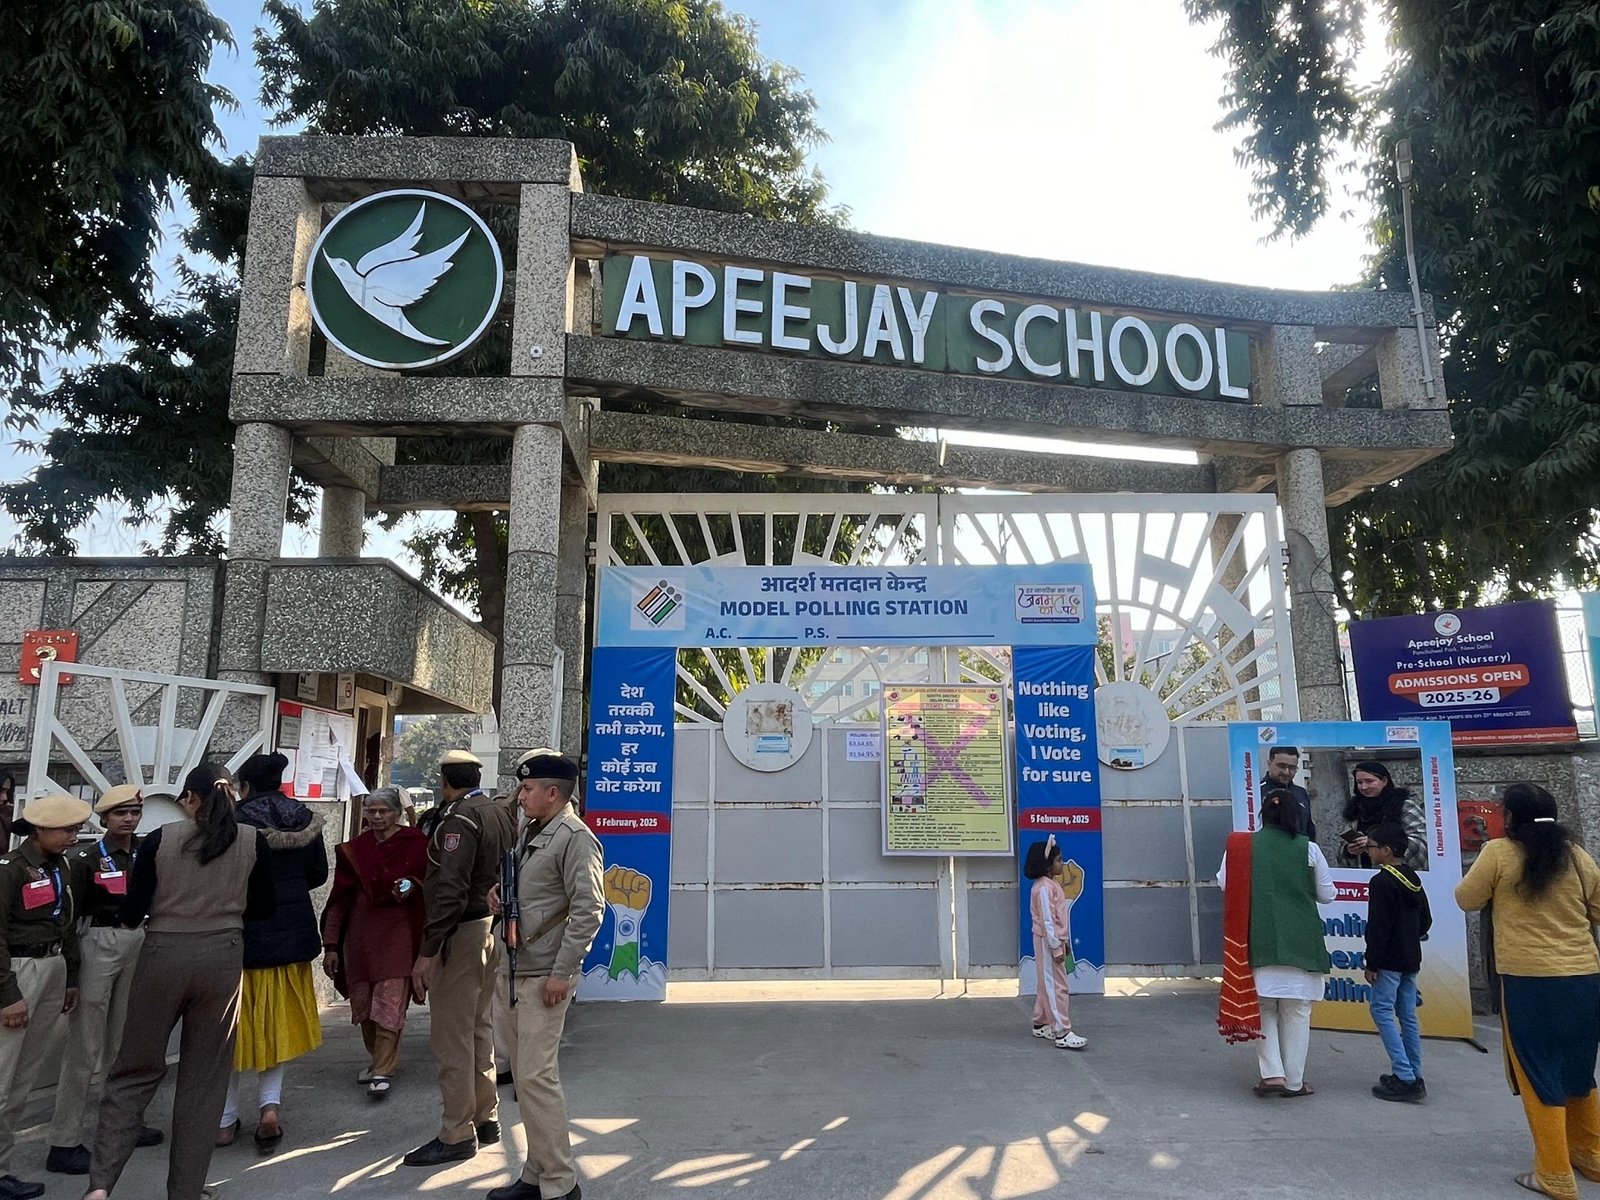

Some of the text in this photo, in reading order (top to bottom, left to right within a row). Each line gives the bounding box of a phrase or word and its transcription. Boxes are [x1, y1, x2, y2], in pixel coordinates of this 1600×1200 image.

[615, 255, 1249, 400] APEEJAY SCHOOL
[761, 571, 927, 593] आदर्श मतदान केन्द्र
[720, 600, 968, 616] MODEL POLLING STATION
[705, 627, 830, 639] A.C. P.S.
[1408, 637, 1453, 650] Apeejay
[1457, 631, 1494, 644] School
[1397, 652, 1511, 669] Pre-School (Nursery)
[1395, 670, 1522, 689] ADMISSIONS OPEN
[620, 683, 644, 699] देश
[1018, 681, 1089, 700] Nothing
[1425, 690, 1493, 704] 2025-26
[608, 702, 655, 717] तरक्की
[1038, 702, 1070, 717] like
[595, 720, 665, 737] तभी करेगा,
[1023, 723, 1087, 742] Voting,
[621, 742, 640, 755] हर
[1031, 745, 1081, 761] I Vote
[601, 758, 657, 776] कोई जब
[1430, 756, 1439, 775] World
[1022, 767, 1092, 783] for sure
[595, 777, 662, 793] वोट करेगा
[596, 818, 658, 828] 5 February, 2025
[1030, 814, 1090, 826] 5 February, 2025
[1433, 809, 1443, 828] World
[1436, 829, 1444, 852] Cleaner
